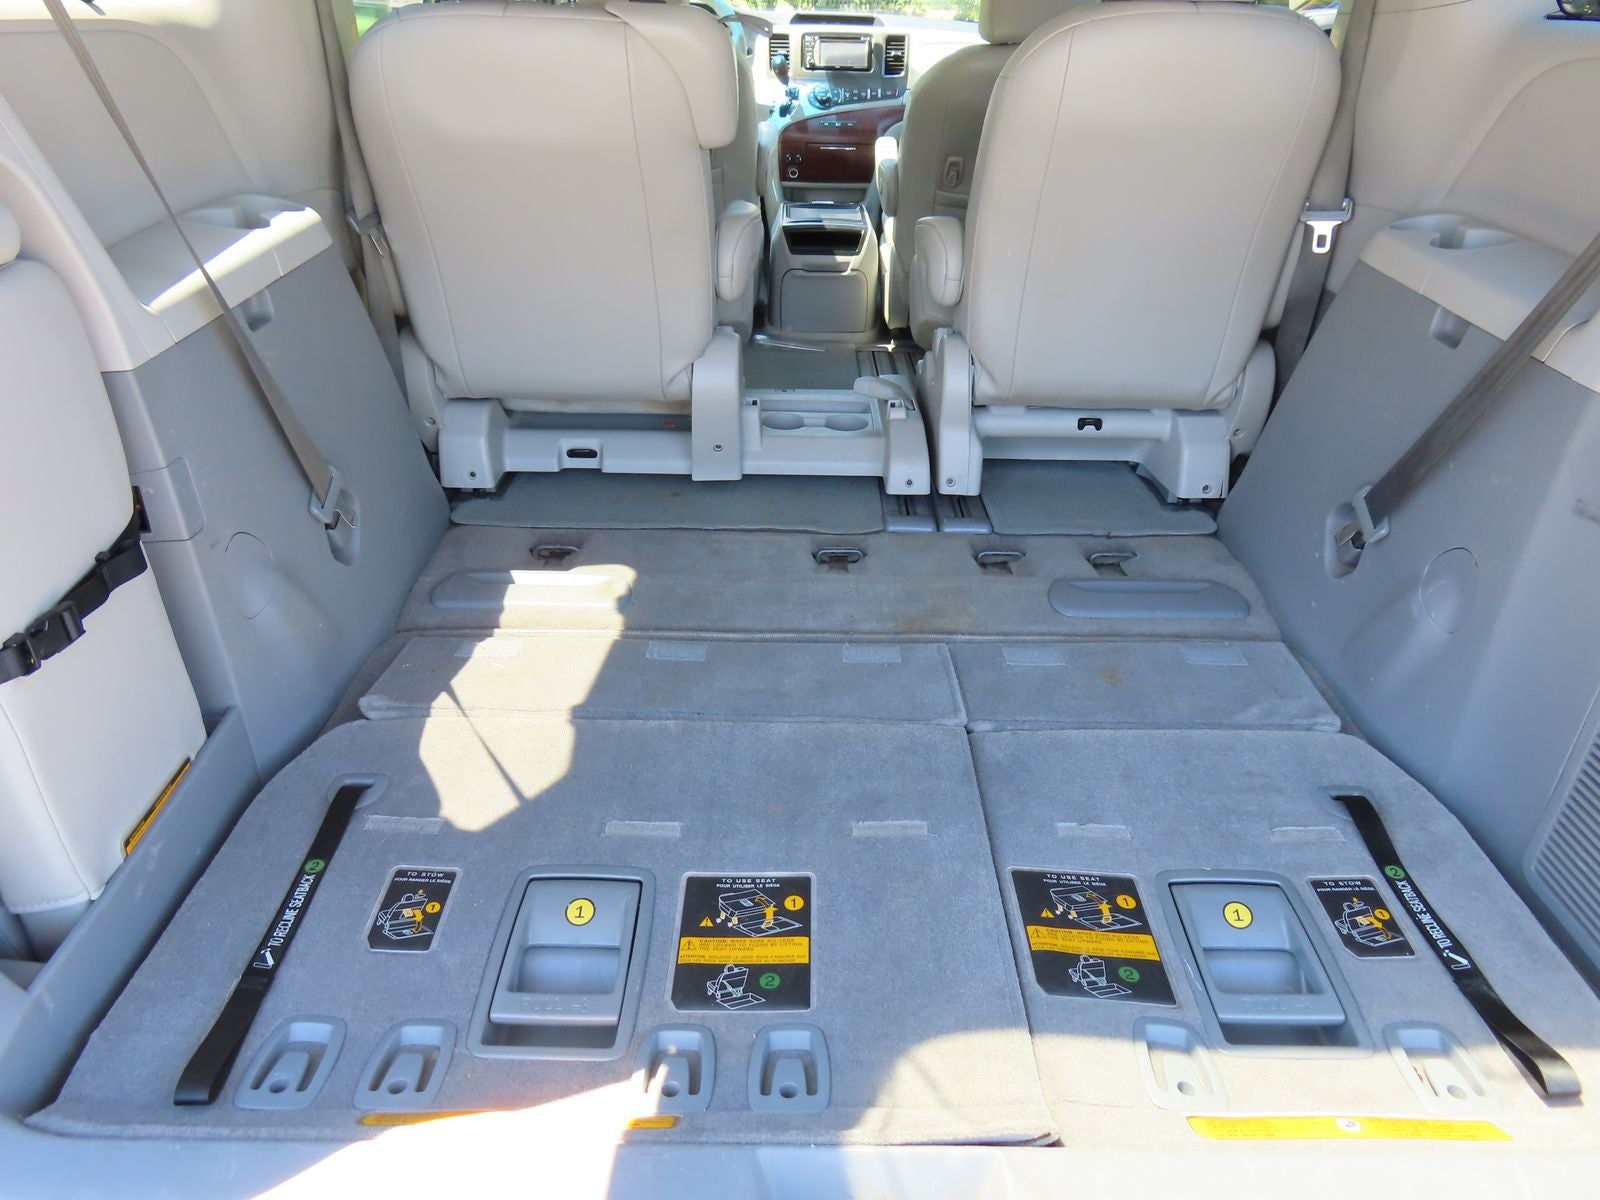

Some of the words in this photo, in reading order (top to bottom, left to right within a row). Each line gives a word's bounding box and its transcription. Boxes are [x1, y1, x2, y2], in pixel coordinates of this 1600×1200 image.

[288, 874, 317, 908] SEATBACK
[1394, 880, 1427, 912] SEATBACK
[273, 908, 300, 938] RECLINE
[1416, 912, 1447, 940] RECLINE
[267, 938, 284, 947] TO
[1436, 938, 1453, 950] TO
